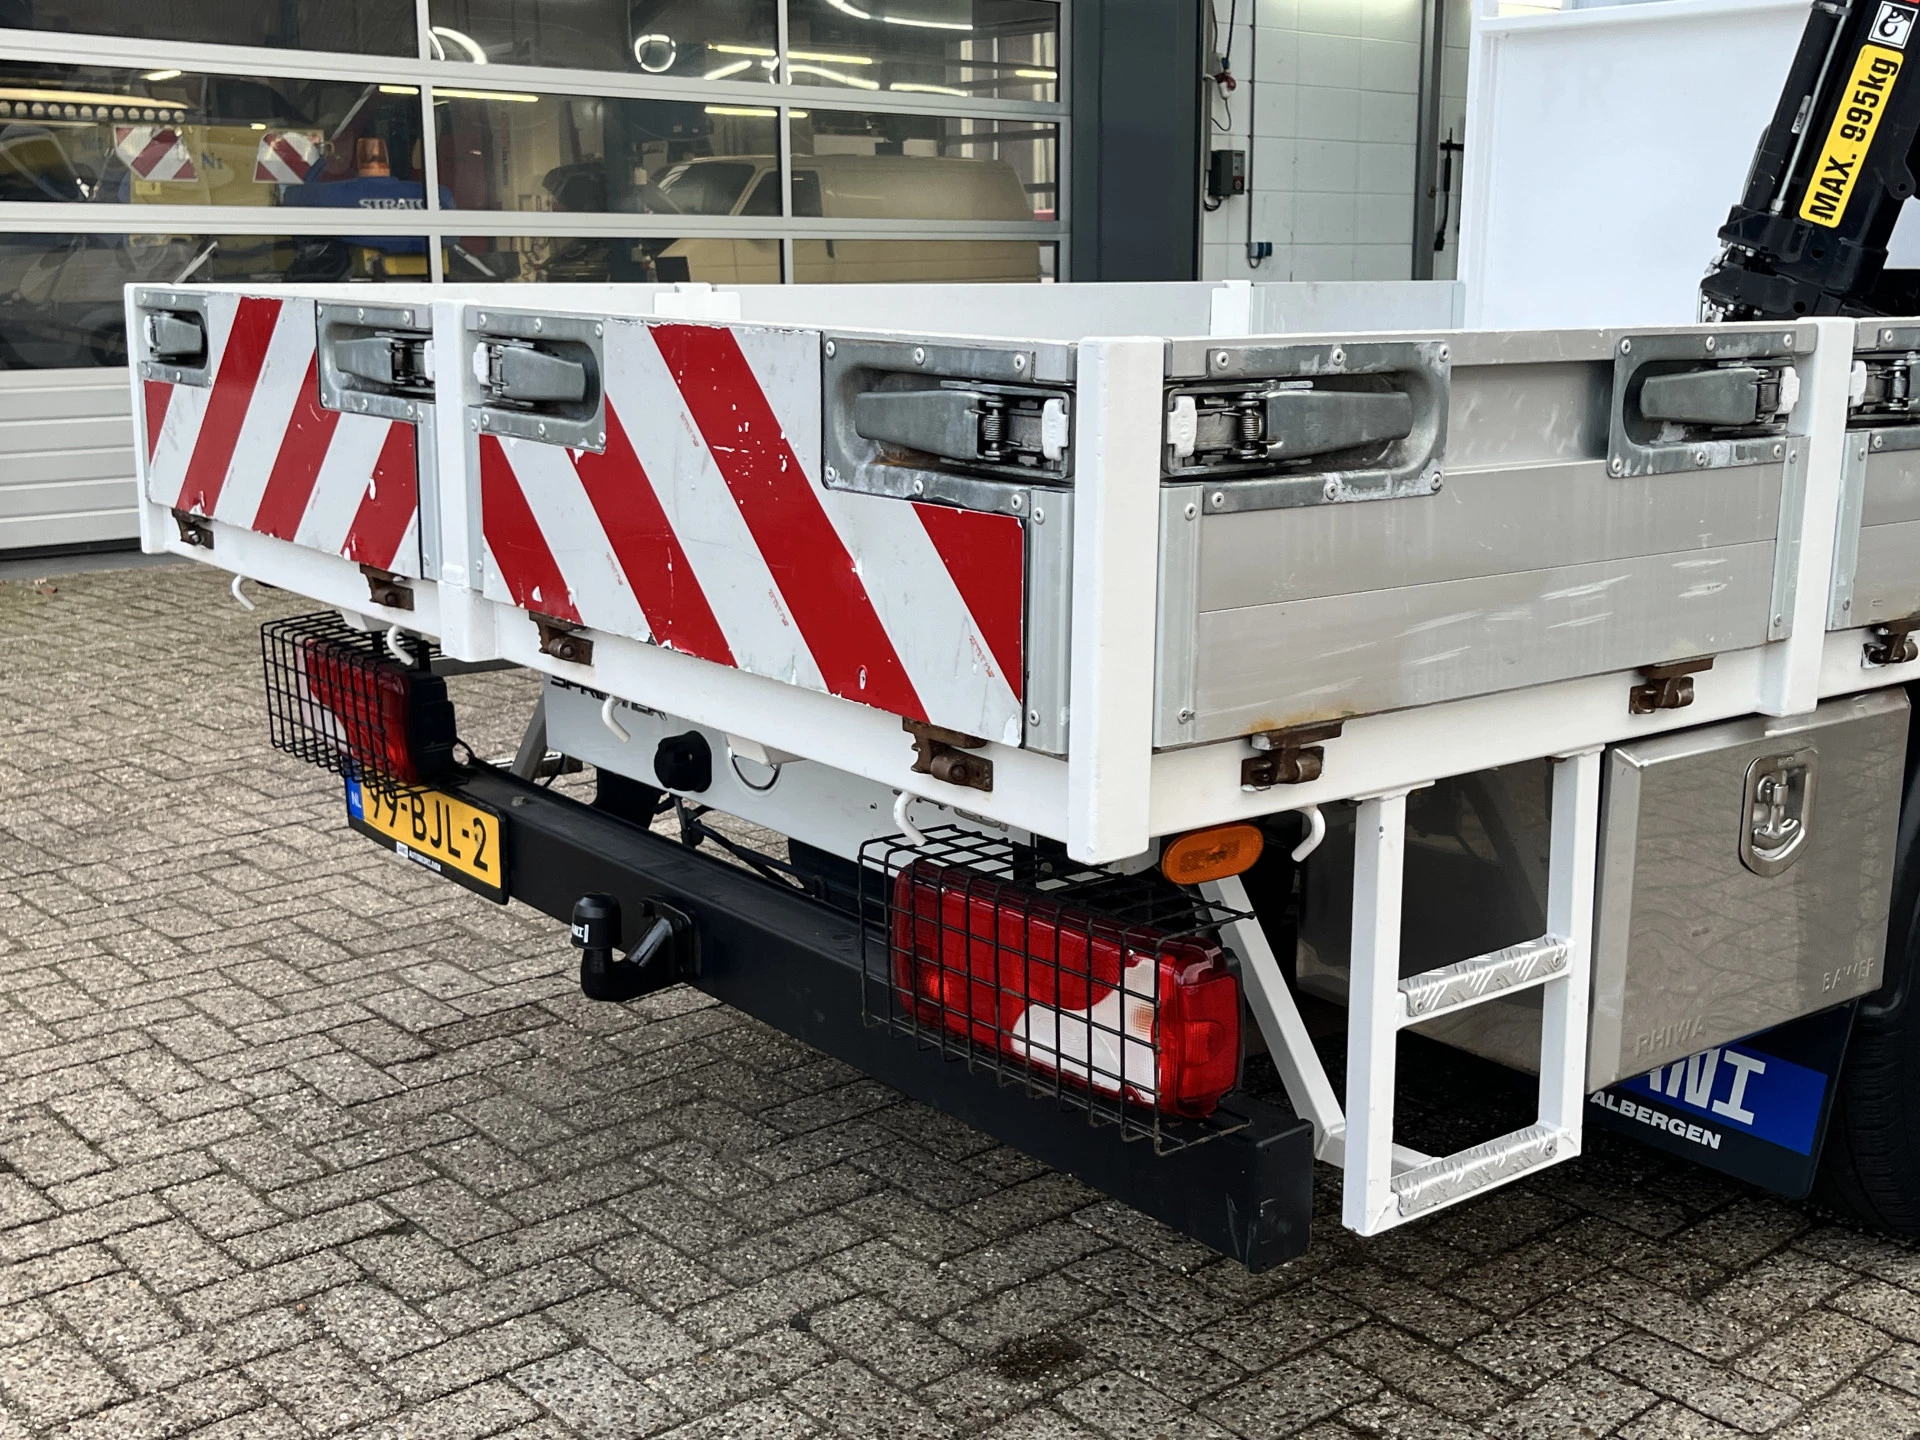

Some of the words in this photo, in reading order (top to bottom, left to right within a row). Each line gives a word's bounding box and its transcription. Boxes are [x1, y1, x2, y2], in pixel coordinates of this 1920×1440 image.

[1808, 153, 1858, 221] MAX.
[1840, 57, 1899, 143] 995kg
[351, 791, 362, 809] NL
[370, 783, 489, 873] 99-BJL-2
[1590, 1090, 1722, 1150] ALBERGEN
